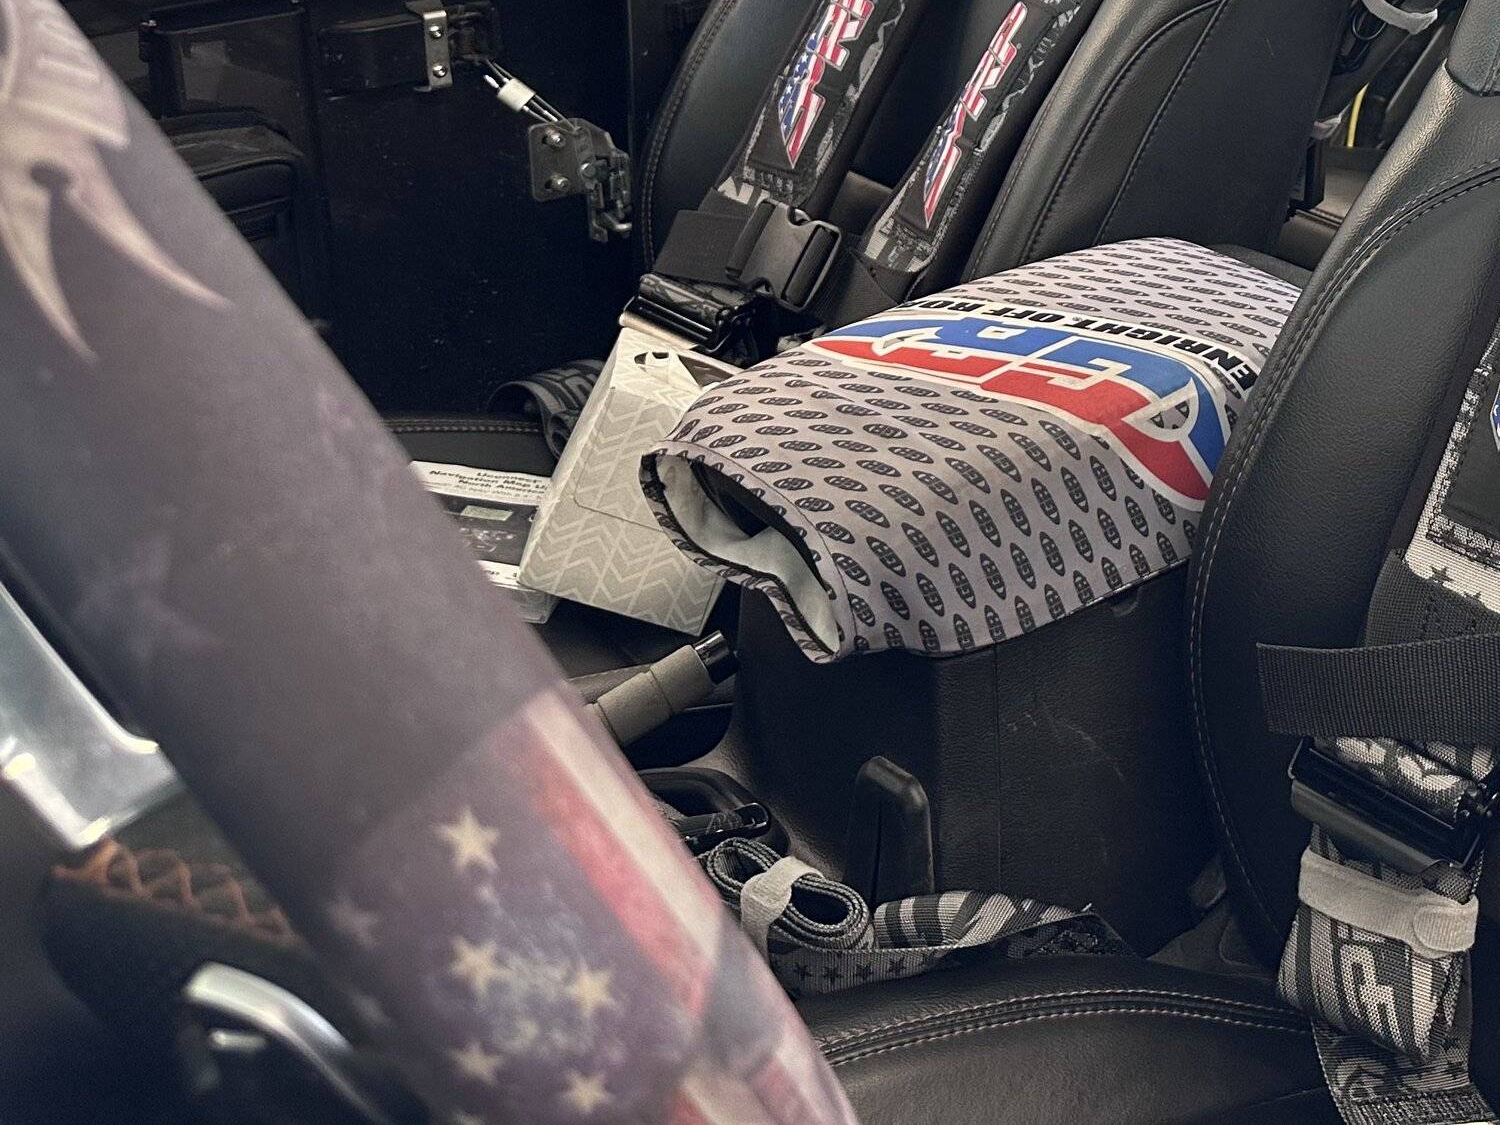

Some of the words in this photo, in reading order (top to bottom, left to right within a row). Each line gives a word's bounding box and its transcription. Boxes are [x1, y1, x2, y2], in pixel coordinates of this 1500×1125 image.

[895, 299, 985, 313] ROA
[982, 307, 1066, 323] OFF
[1063, 316, 1259, 391] ENRIGHT
[429, 469, 499, 485] Navigation
[502, 478, 531, 488] Map
[458, 479, 492, 489] North
[496, 484, 545, 495] America
